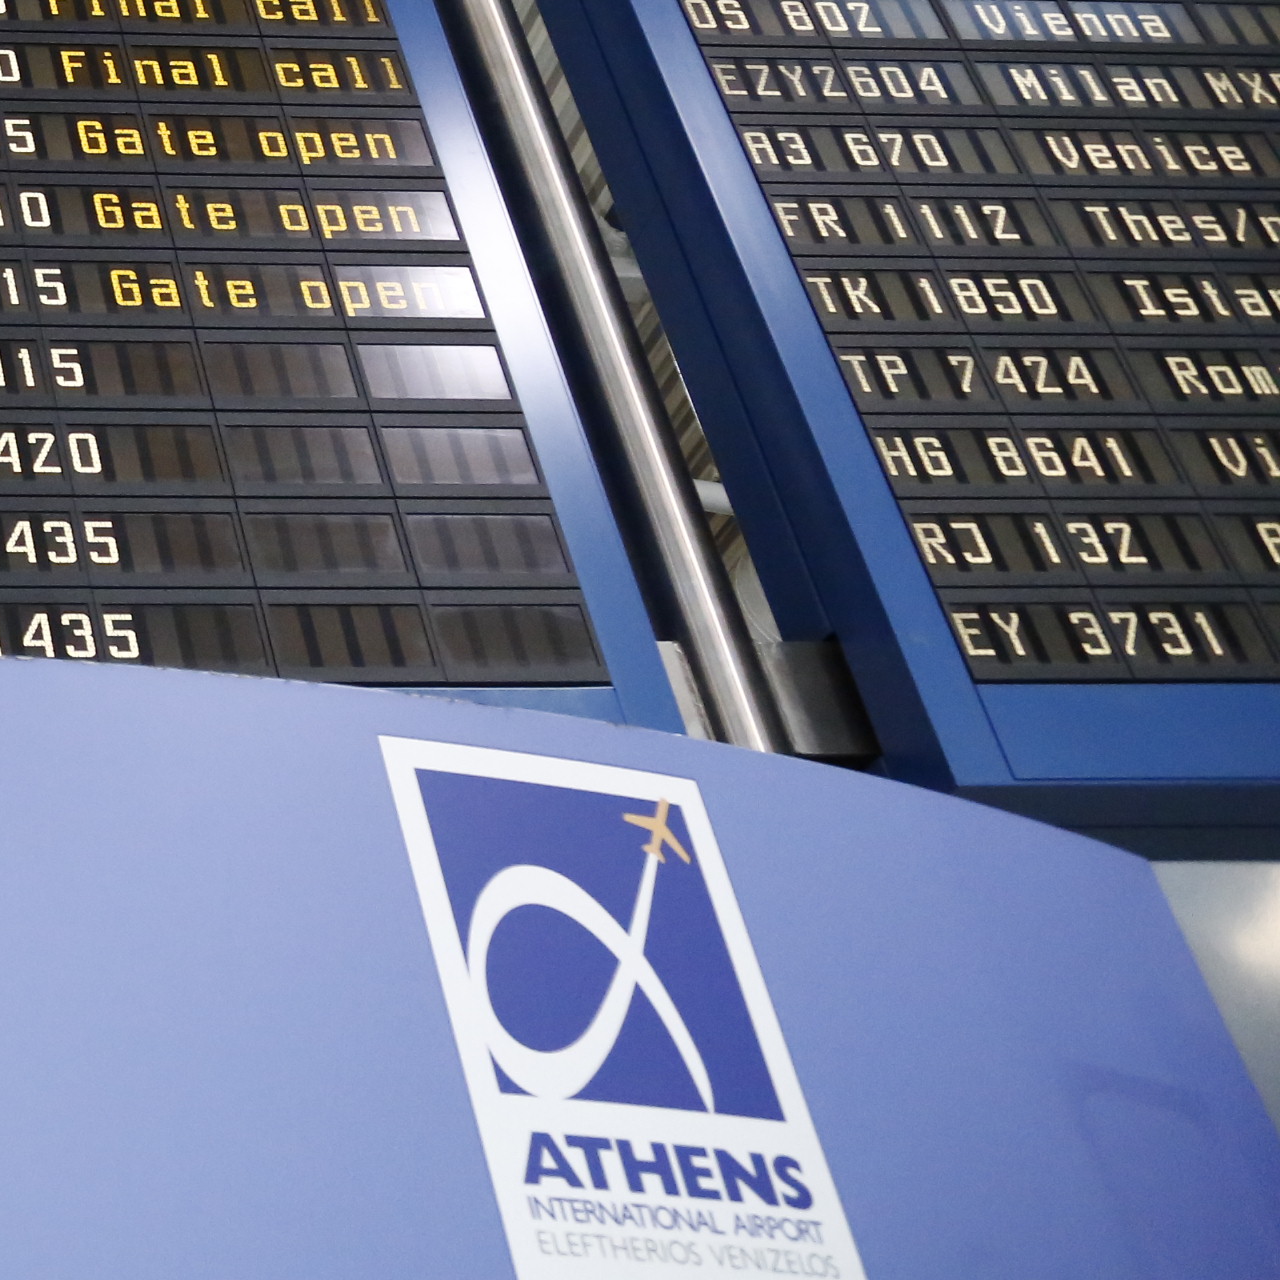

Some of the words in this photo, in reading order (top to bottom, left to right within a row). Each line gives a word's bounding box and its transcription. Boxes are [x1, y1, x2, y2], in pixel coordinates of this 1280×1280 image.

[685, 0, 750, 29] OS
[781, 1, 881, 32] 802
[972, 3, 1172, 38] Vienna
[61, 51, 228, 85] Final
[275, 57, 402, 88] call
[743, 132, 812, 164] A3
[844, 134, 948, 166] 670
[1046, 136, 1251, 171] Venice
[806, 278, 881, 313] TK
[919, 278, 1057, 314] 1850
[913, 523, 992, 563] RJ
[1034, 523, 1147, 563] 132
[952, 613, 1025, 655] EY
[1069, 612, 1223, 655] 3731
[524, 1131, 814, 1210] ATHENS
[527, 1196, 725, 1235] INTERNATIONAL
[734, 1214, 824, 1244] AIRPORT
[536, 1230, 703, 1266] ELEFTHERIOS
[708, 1243, 841, 1279] VENIZELOS
